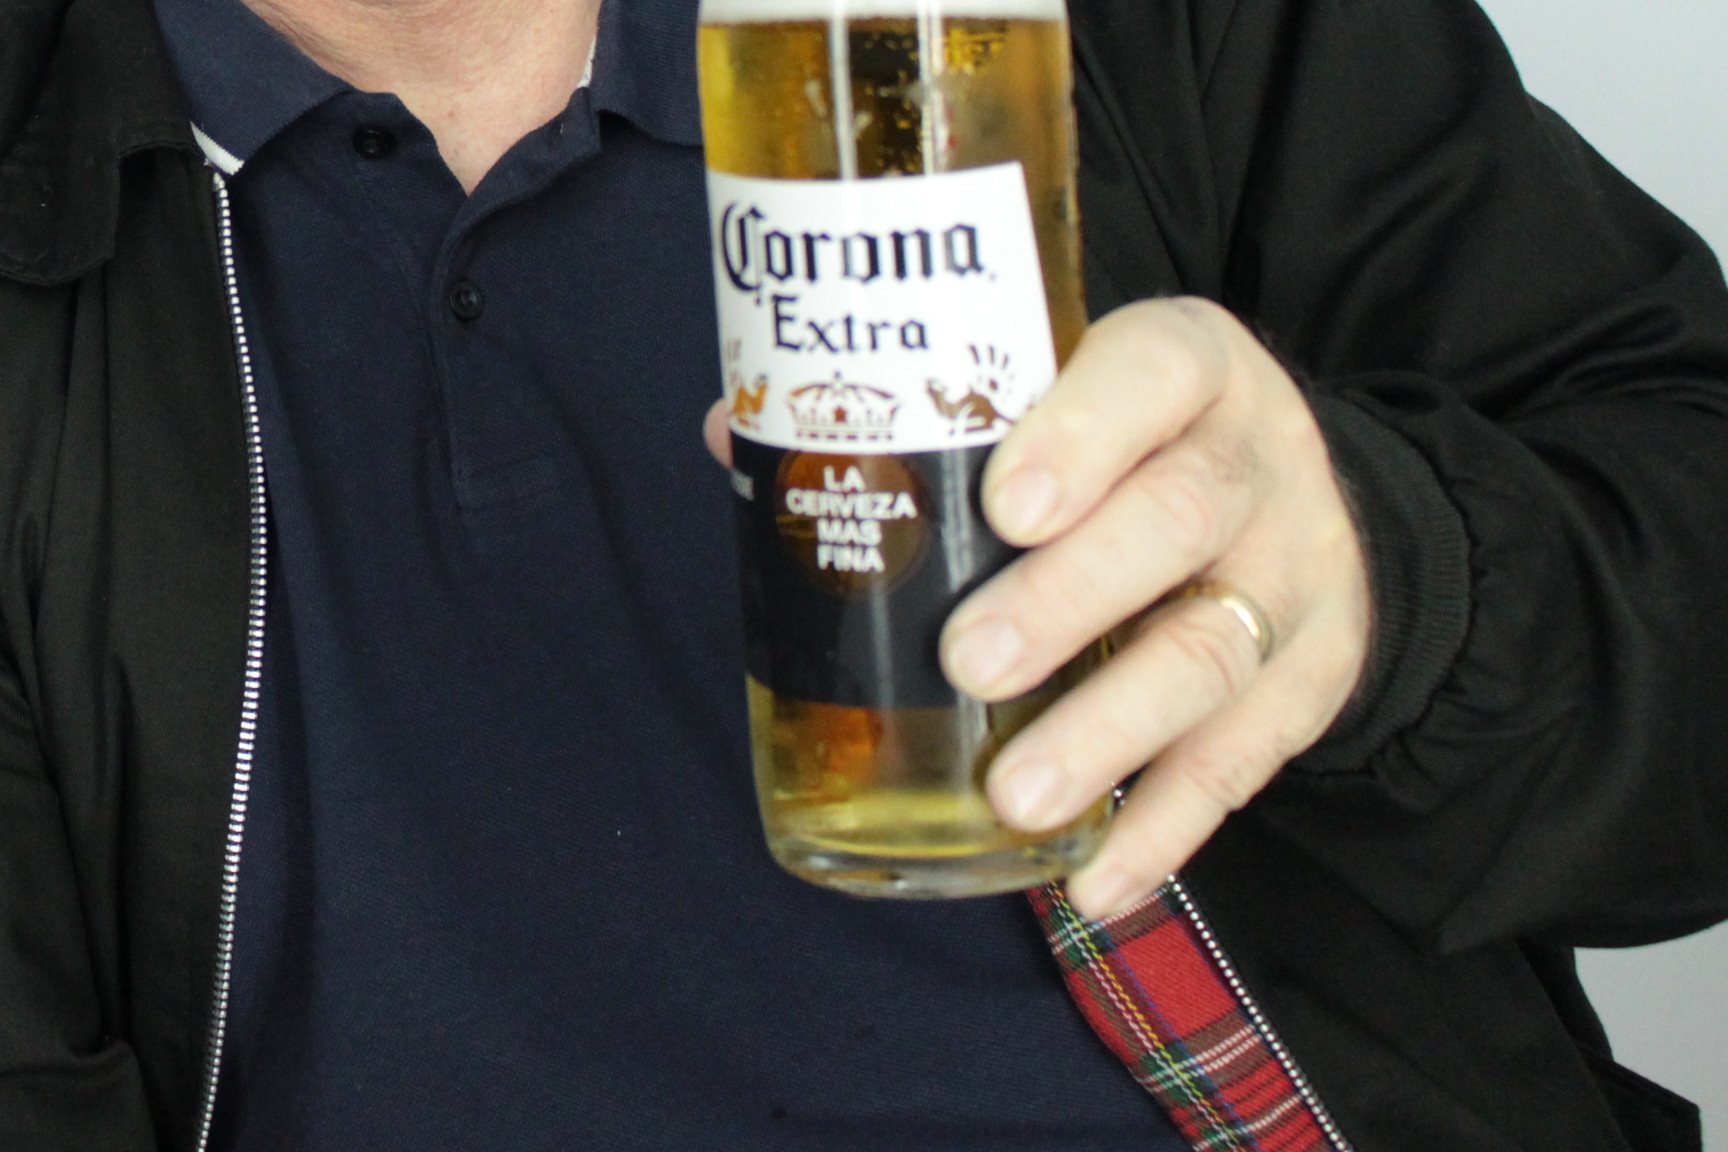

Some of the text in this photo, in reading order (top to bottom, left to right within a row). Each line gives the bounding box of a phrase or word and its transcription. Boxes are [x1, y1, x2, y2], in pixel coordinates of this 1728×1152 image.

[721, 201, 985, 307] Corona
[771, 294, 930, 353] Extra
[823, 464, 866, 493] LA
[785, 487, 918, 520] CERVEZA
[817, 544, 885, 572] FINA
